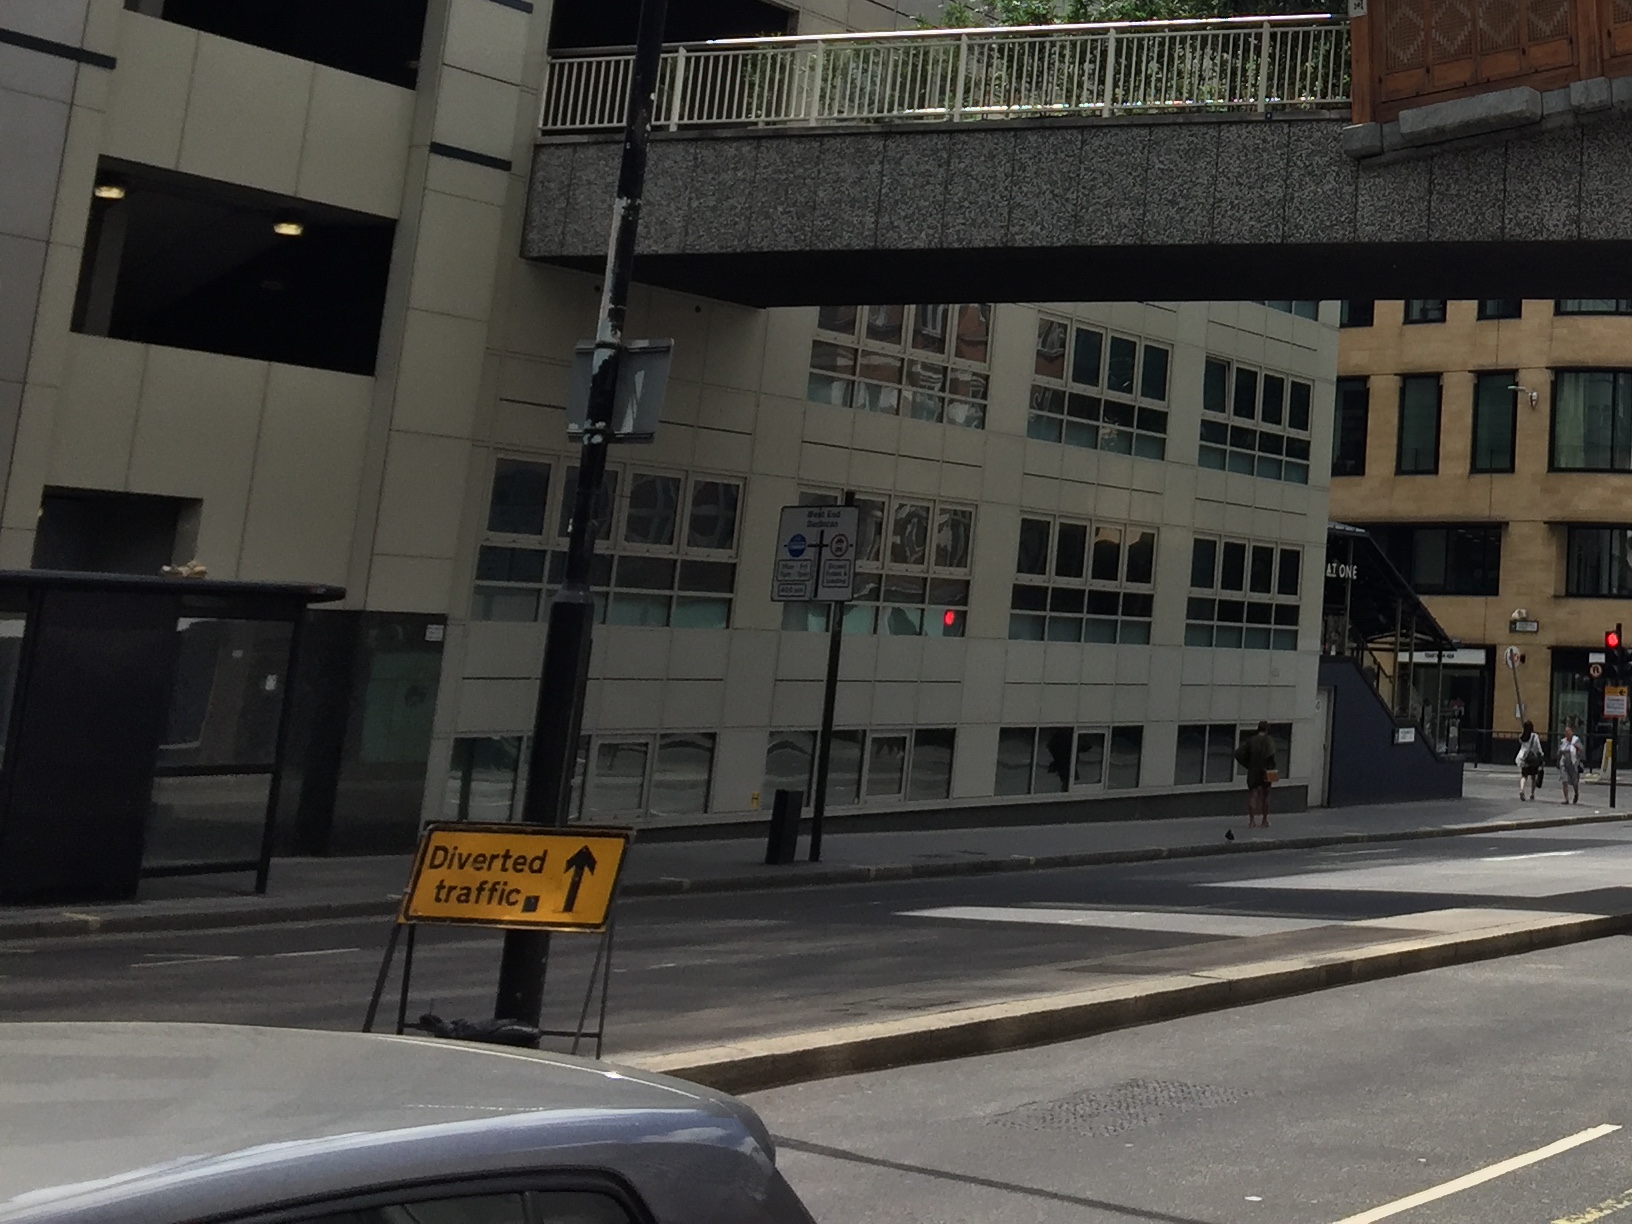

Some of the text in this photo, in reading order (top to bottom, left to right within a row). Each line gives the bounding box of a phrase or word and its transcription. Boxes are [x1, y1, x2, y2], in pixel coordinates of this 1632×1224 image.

[1338, 563, 1358, 580] ONE
[427, 844, 548, 874] Diverted
[433, 879, 521, 908] traffic
